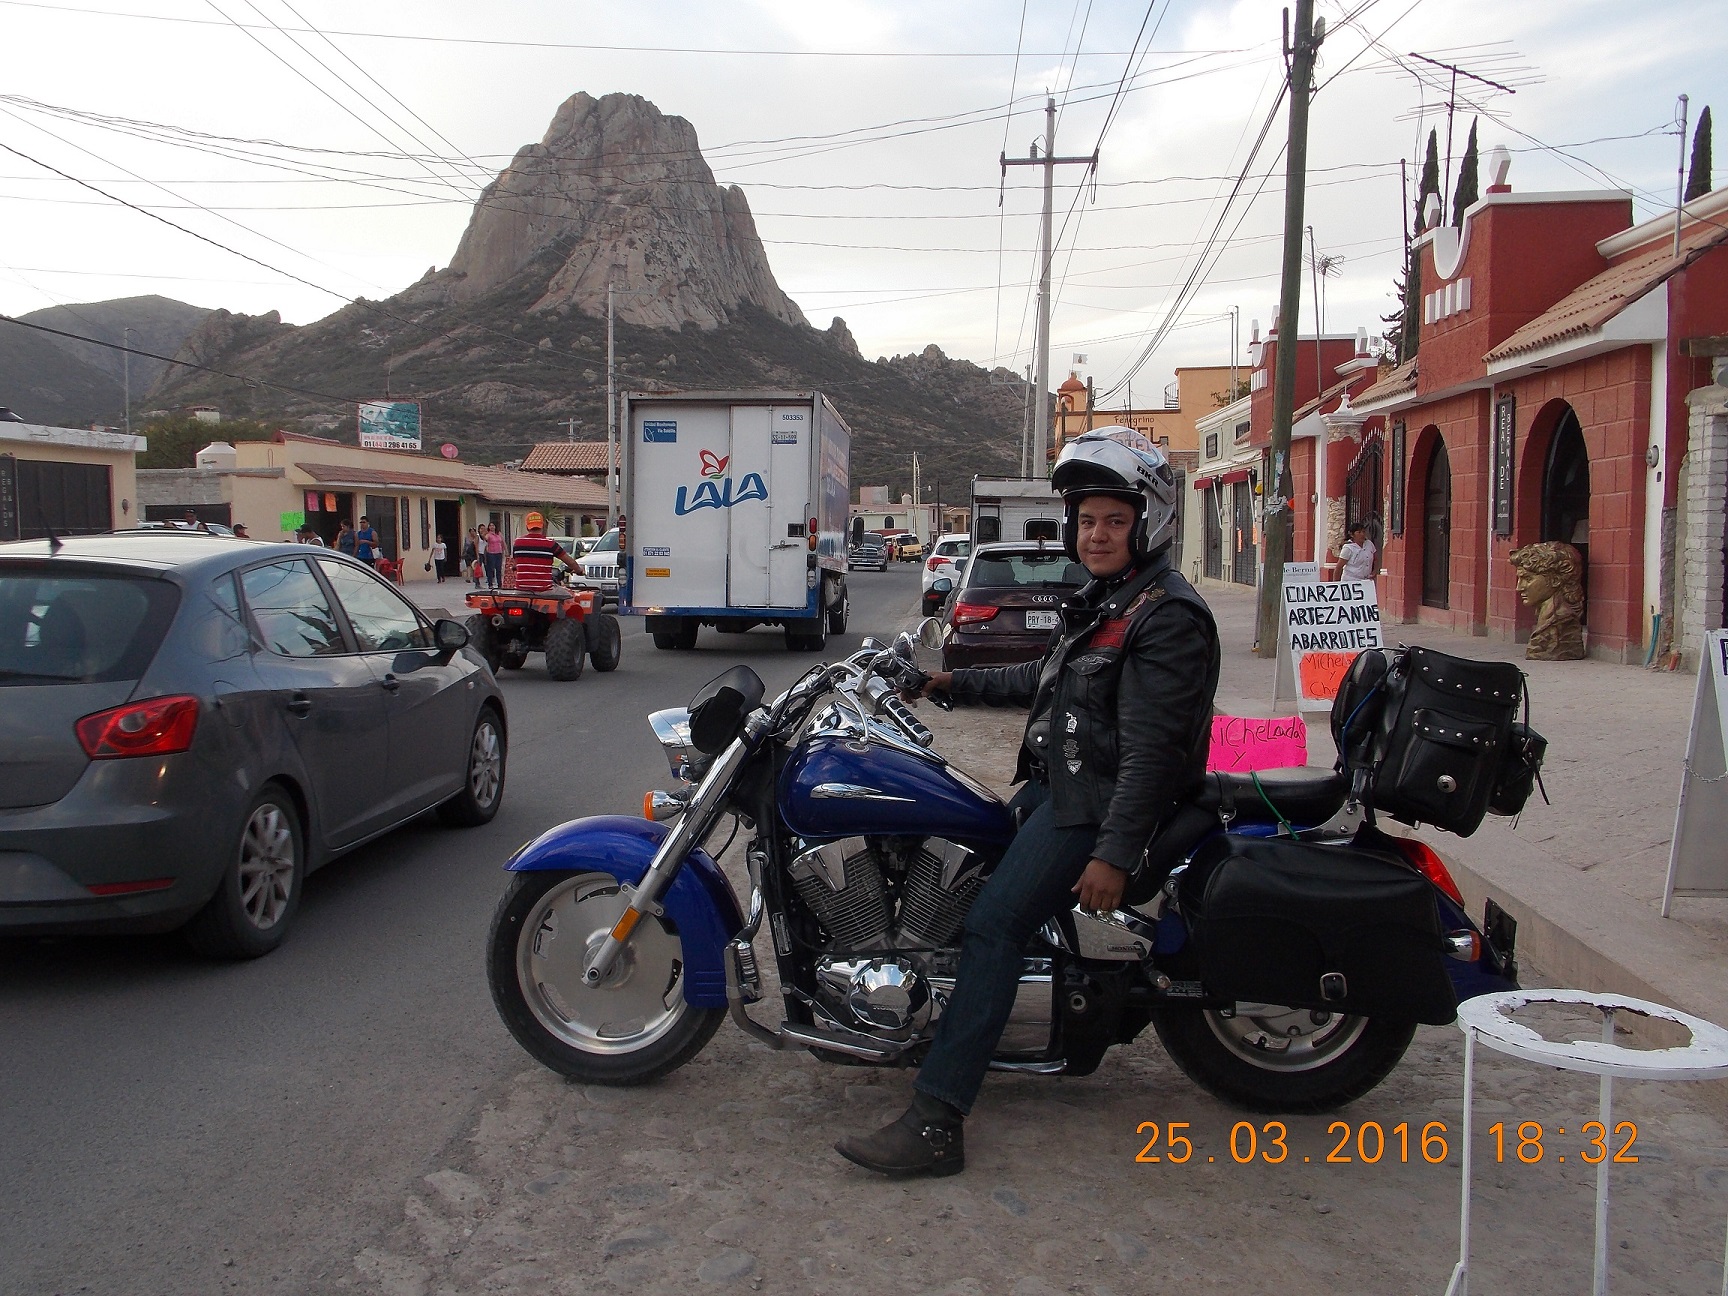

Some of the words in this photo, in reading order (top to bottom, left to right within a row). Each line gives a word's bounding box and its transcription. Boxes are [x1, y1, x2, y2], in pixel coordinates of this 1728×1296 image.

[1136, 465, 1159, 487] BKR
[1500, 466, 1505, 490] DE
[675, 472, 769, 515] LALA
[1285, 583, 1364, 603] CUARZOS
[1027, 615, 1060, 624] PRY-18-4
[1291, 627, 1378, 650] ABARROTES
[1309, 681, 1338, 697] Che
